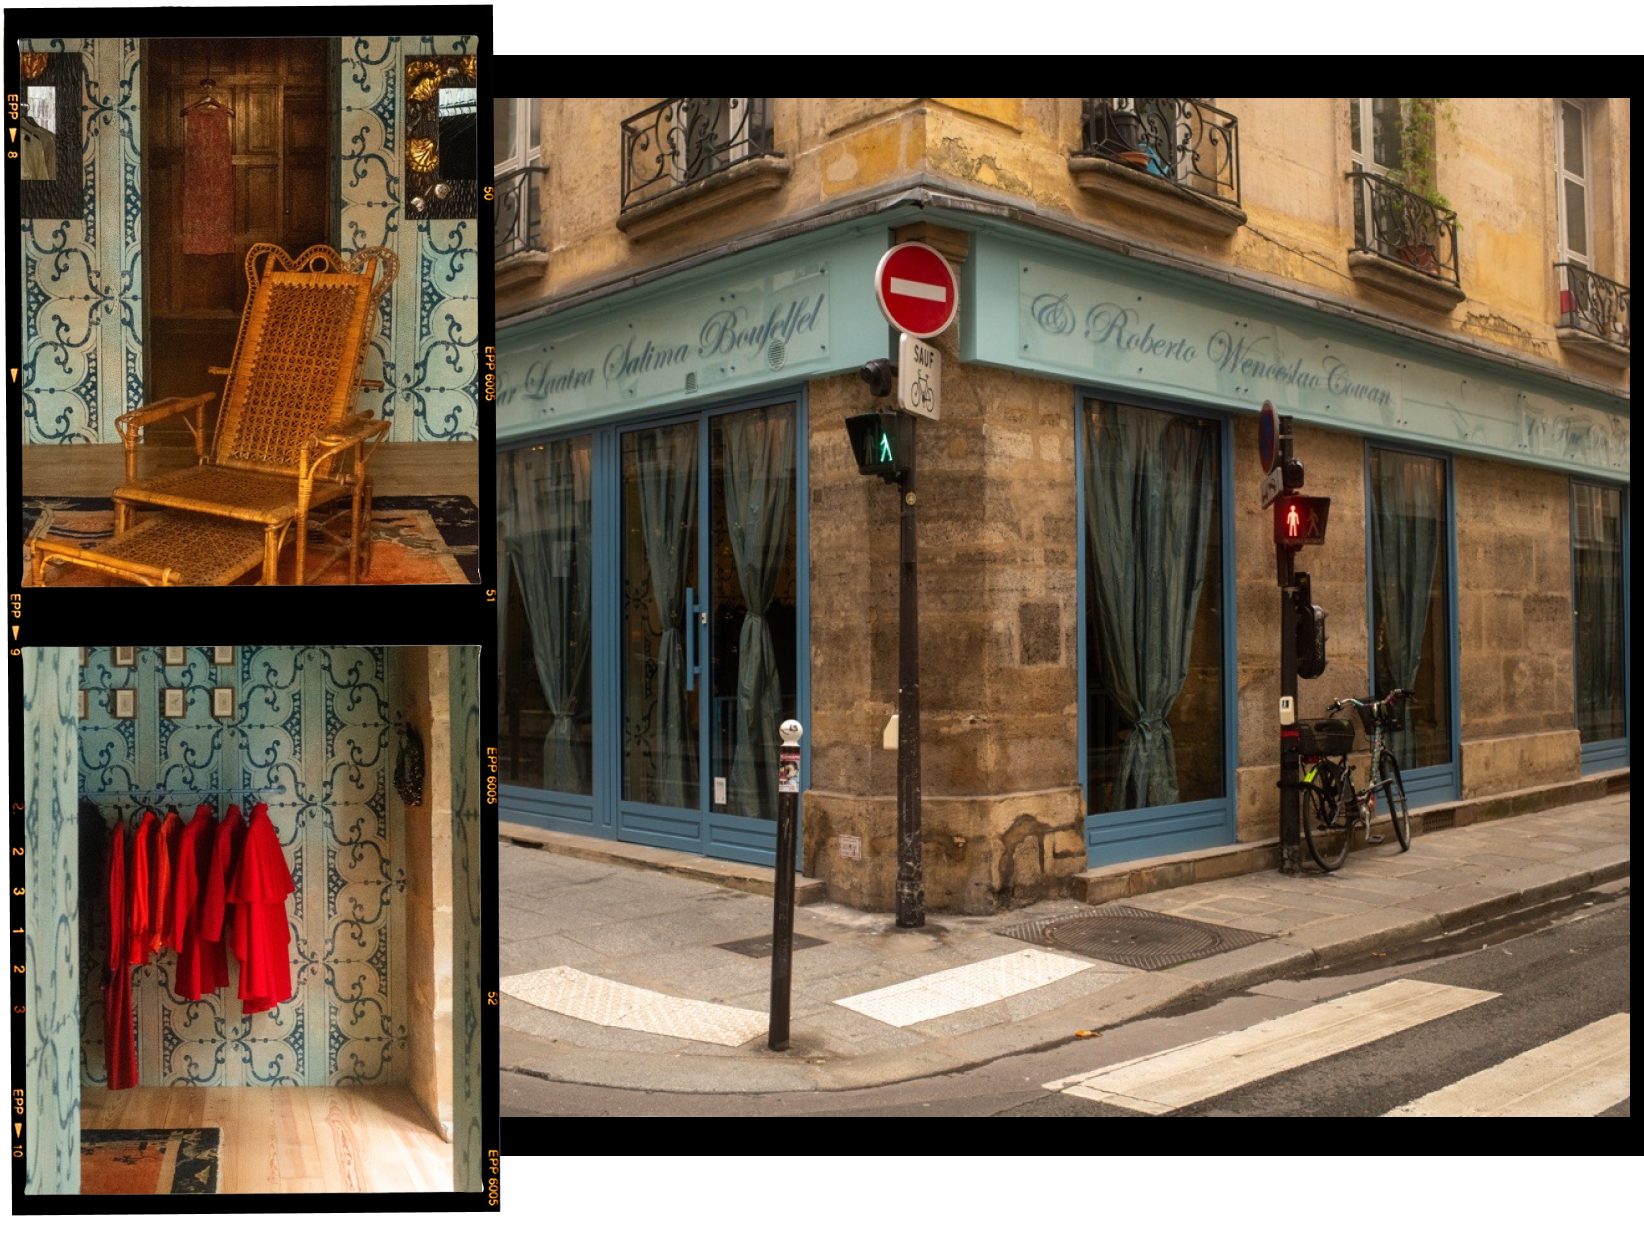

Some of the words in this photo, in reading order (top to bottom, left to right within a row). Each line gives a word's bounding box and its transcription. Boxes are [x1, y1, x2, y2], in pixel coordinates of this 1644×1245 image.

[7, 93, 19, 120] EPP
[7, 150, 19, 160] 8
[483, 186, 494, 201] 50
[485, 346, 496, 370] EPP
[913, 343, 935, 369] SAUF
[1084, 302, 1198, 362] Roberto
[1322, 355, 1393, 406] Cowan
[485, 373, 496, 402] 6005
[10, 593, 21, 619] EPP
[485, 589, 497, 602] 51
[10, 647, 21, 657] 9
[486, 747, 498, 773] EPP
[486, 775, 498, 805] 6005
[13, 847, 25, 856] 2
[13, 886, 25, 896] 3
[14, 965, 25, 974] 2
[14, 1005, 25, 1014] 3
[487, 991, 498, 1006] 52
[13, 1088, 24, 1115] EPP
[13, 1144, 24, 1158] 10
[488, 1149, 499, 1174] EPP
[488, 1177, 499, 1207] 6005
